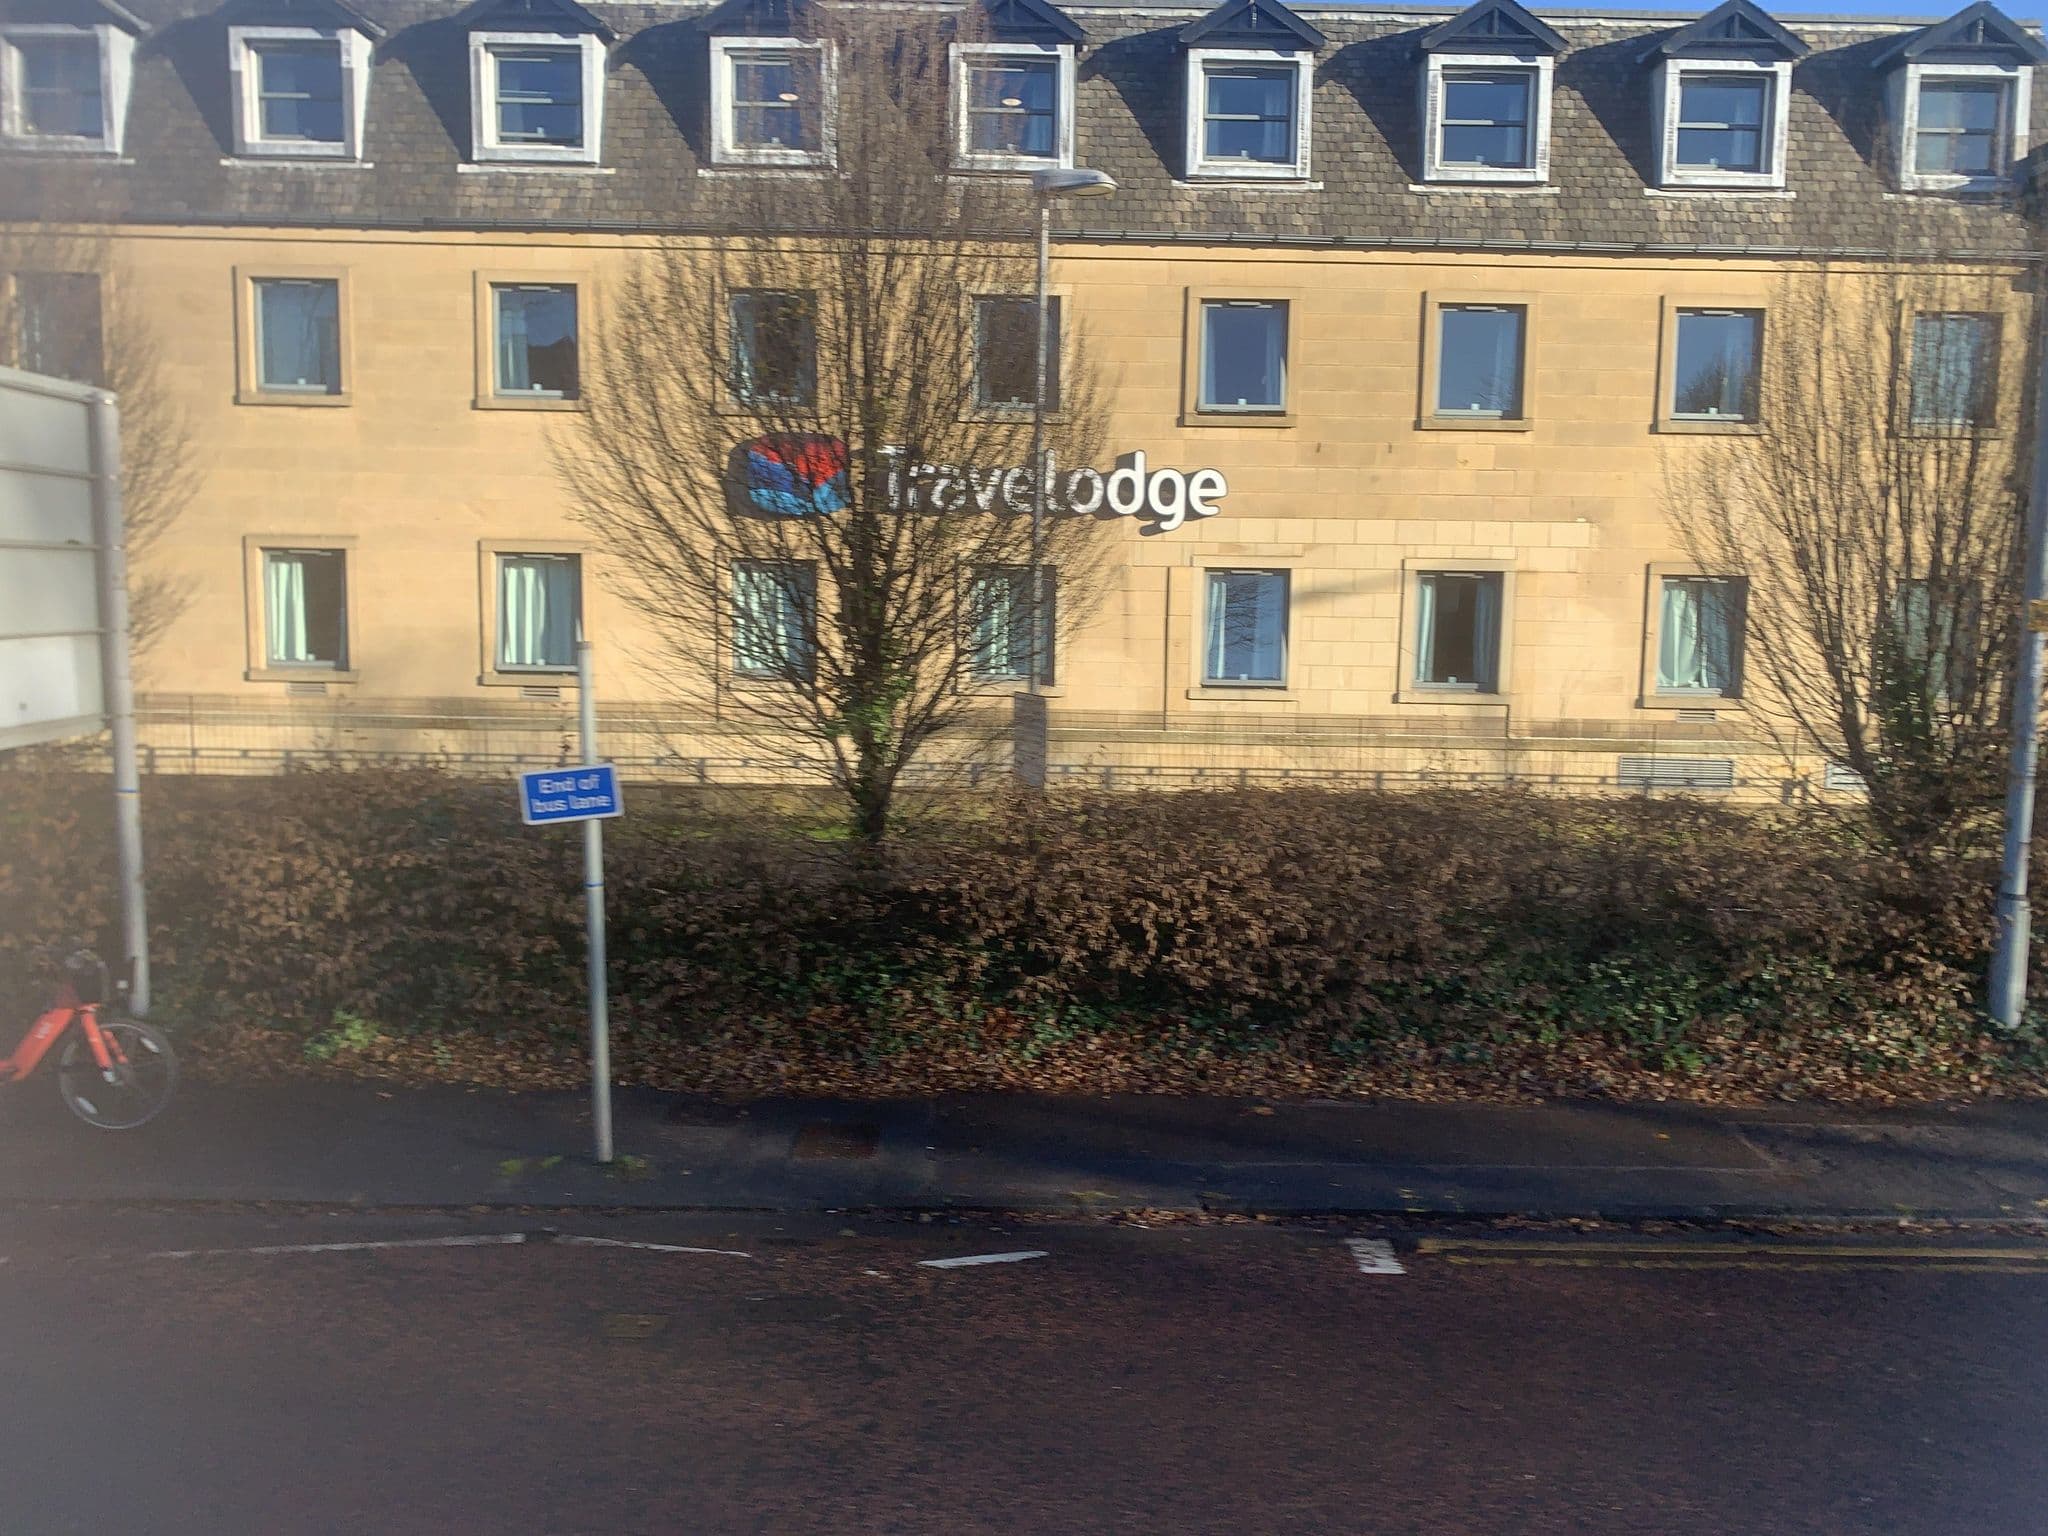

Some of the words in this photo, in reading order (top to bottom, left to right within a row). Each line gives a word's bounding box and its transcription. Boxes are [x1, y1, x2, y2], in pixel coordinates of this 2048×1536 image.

[537, 776, 576, 794] End
[577, 774, 601, 790] of
[530, 797, 568, 813] bus
[568, 795, 612, 809] lane
